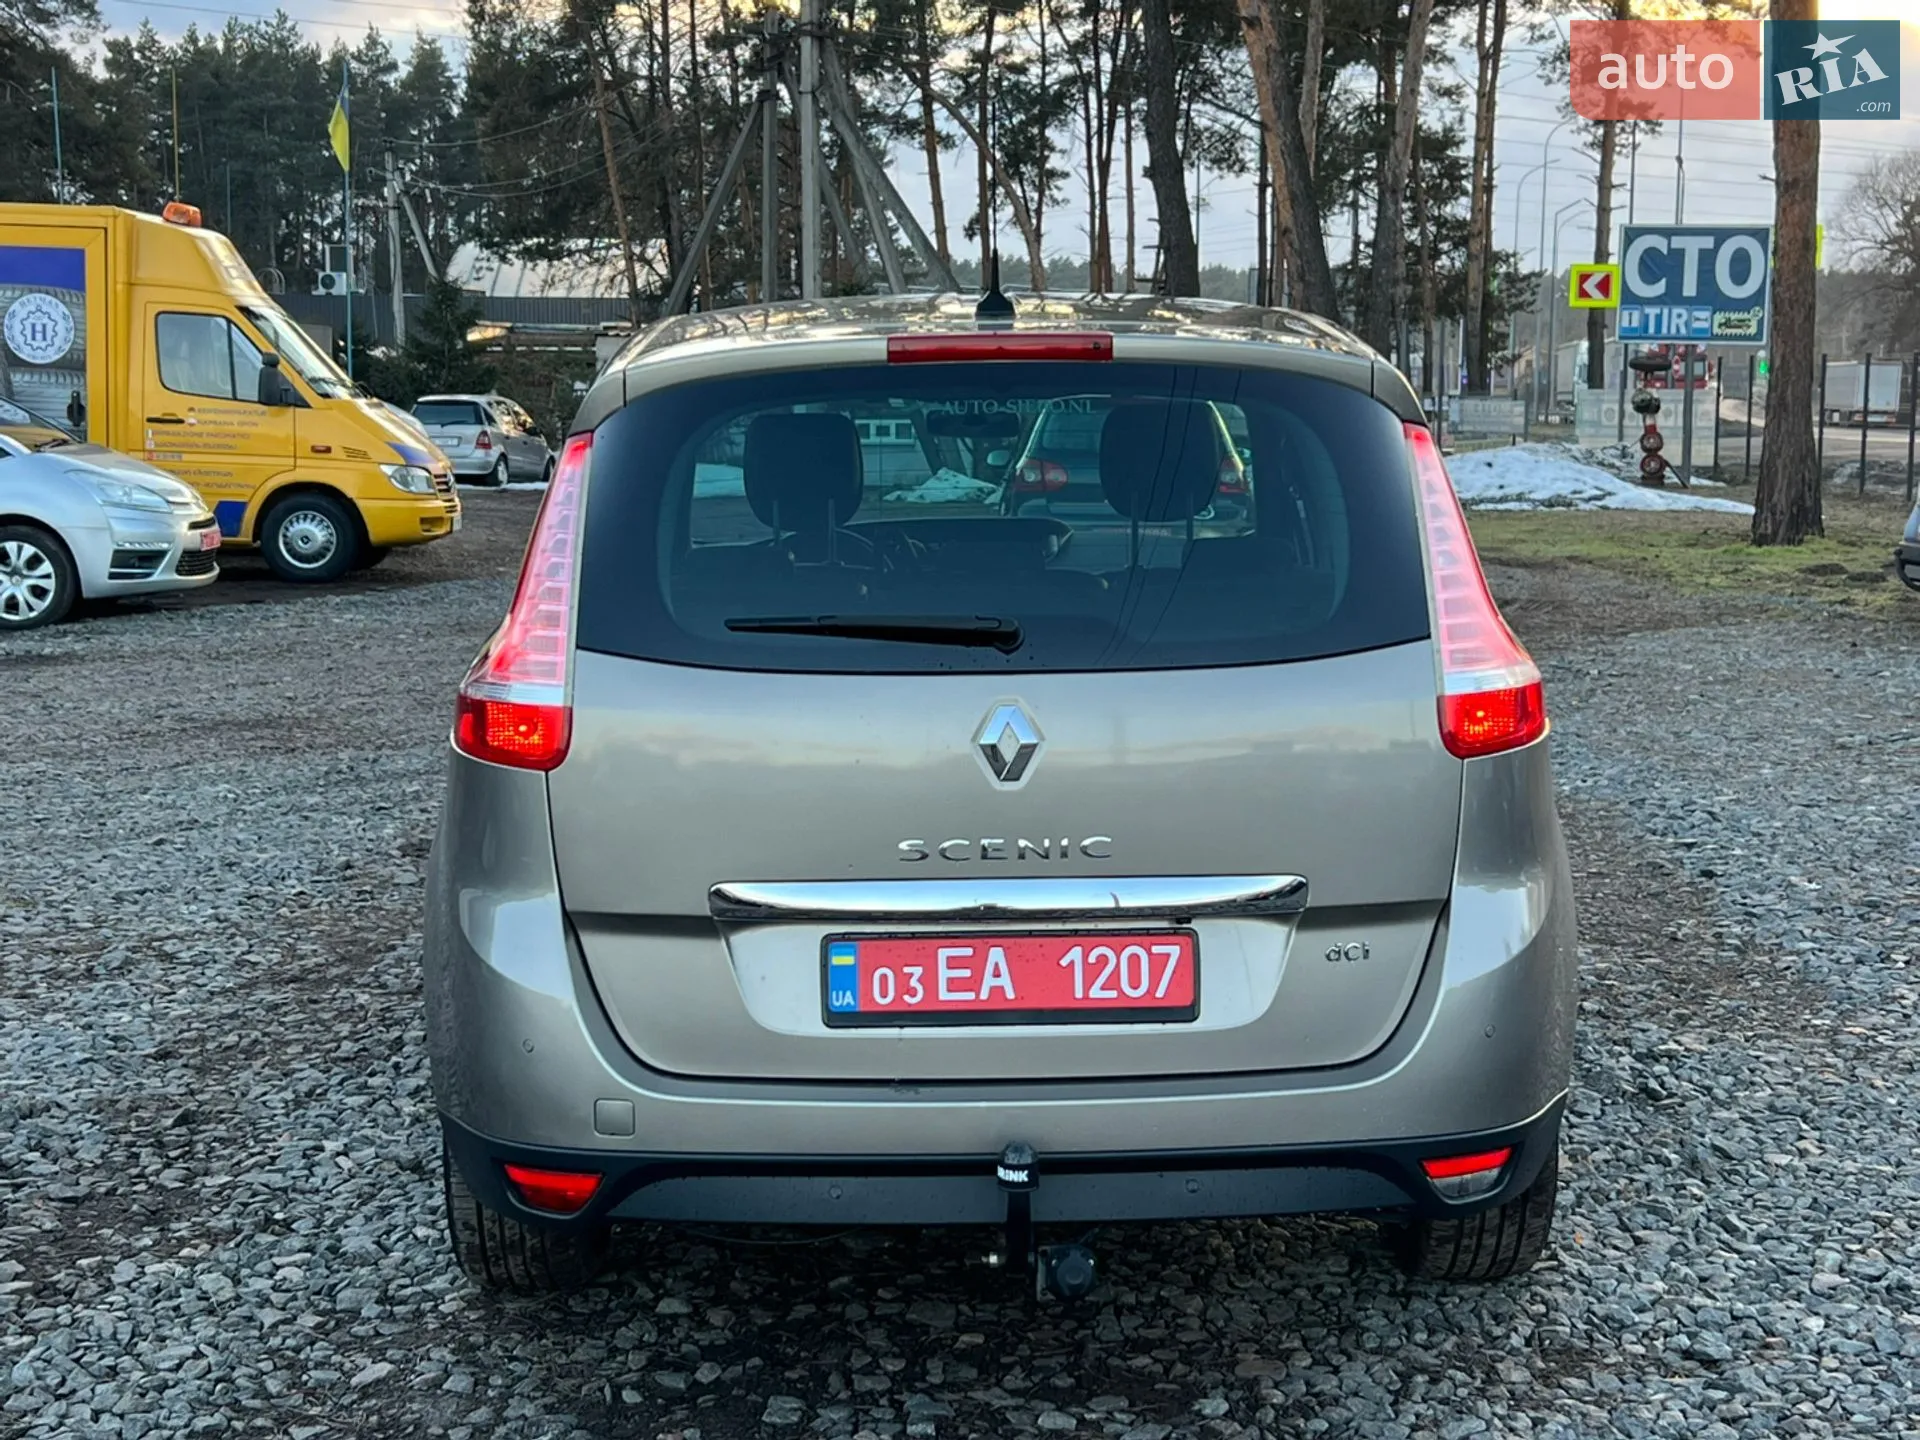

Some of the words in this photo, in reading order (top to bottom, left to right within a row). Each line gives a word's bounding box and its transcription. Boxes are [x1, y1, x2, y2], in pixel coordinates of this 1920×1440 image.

[1624, 233, 1766, 299] СТО
[30, 322, 48, 342] H
[1644, 307, 1689, 336] TIR
[898, 836, 1112, 862] SCENIC
[1325, 942, 1370, 962] dCi
[872, 966, 924, 1005] 03
[937, 946, 1016, 1001] EA
[1058, 944, 1182, 999] 1207
[831, 990, 855, 1007] UA
